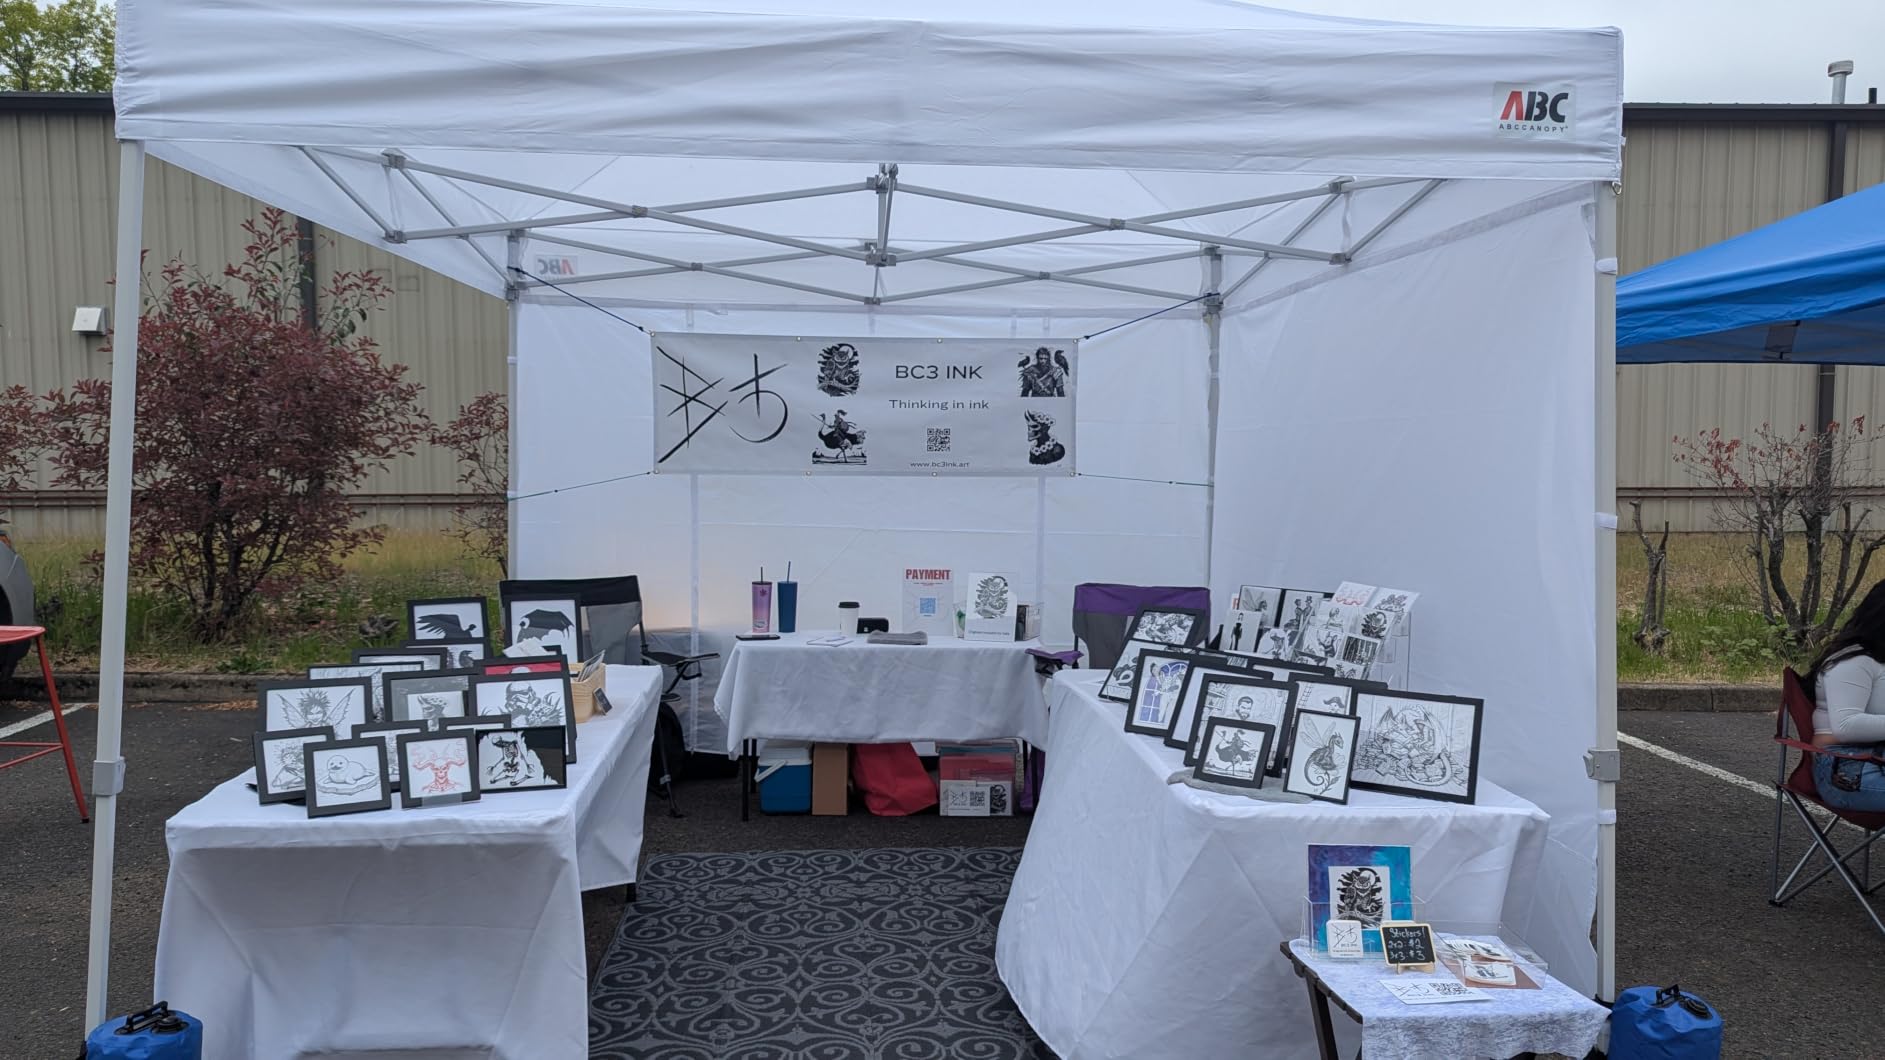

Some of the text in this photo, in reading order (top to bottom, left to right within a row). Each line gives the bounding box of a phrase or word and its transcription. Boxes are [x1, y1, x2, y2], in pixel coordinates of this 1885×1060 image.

[1500, 90, 1569, 123] ABC
[1499, 123, 1568, 133] ABCCANOPY
[895, 365, 983, 379] BC3 INK
[889, 399, 989, 410] Thinking in ink
[905, 568, 951, 580] PAYMENT
